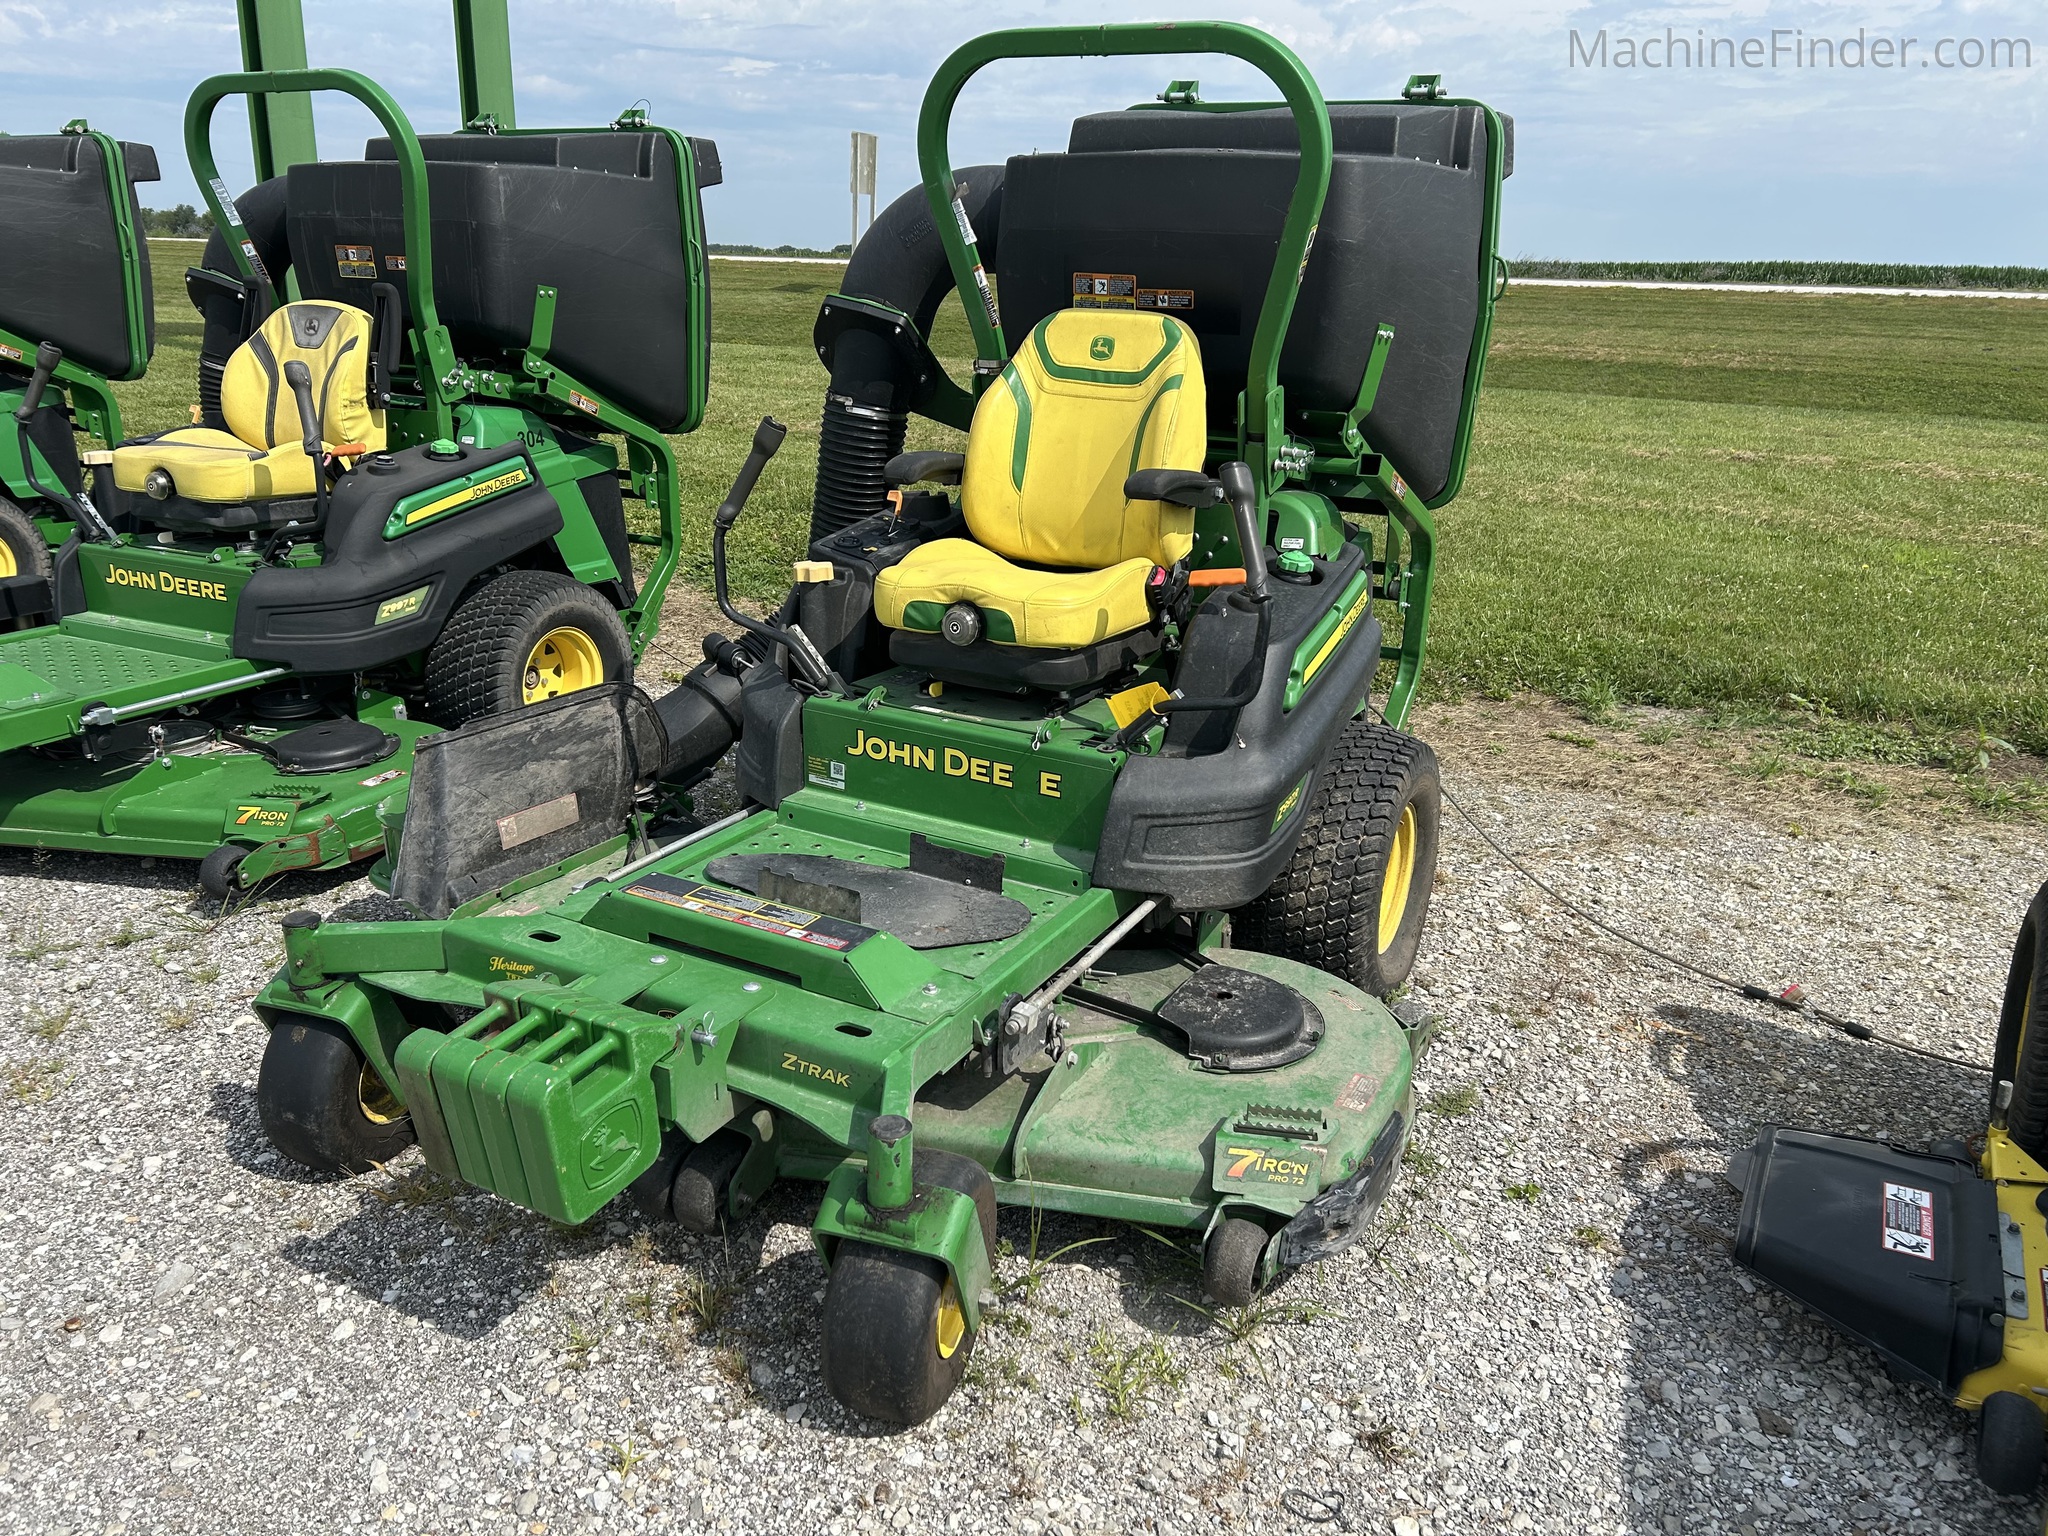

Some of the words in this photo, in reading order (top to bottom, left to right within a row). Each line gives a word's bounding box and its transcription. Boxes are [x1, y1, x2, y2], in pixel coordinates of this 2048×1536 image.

[517, 429, 545, 448] 304
[471, 483, 494, 499] JOHN
[494, 473, 521, 490] DEERE
[105, 563, 157, 591] JOHN
[158, 570, 228, 602] DEERE
[846, 728, 936, 773] JOHN
[489, 956, 536, 975] Heritage
[781, 1052, 850, 1088] ZTRAK
[1267, 1174, 1289, 1184] PRO
[1292, 1177, 1305, 1186] 72
